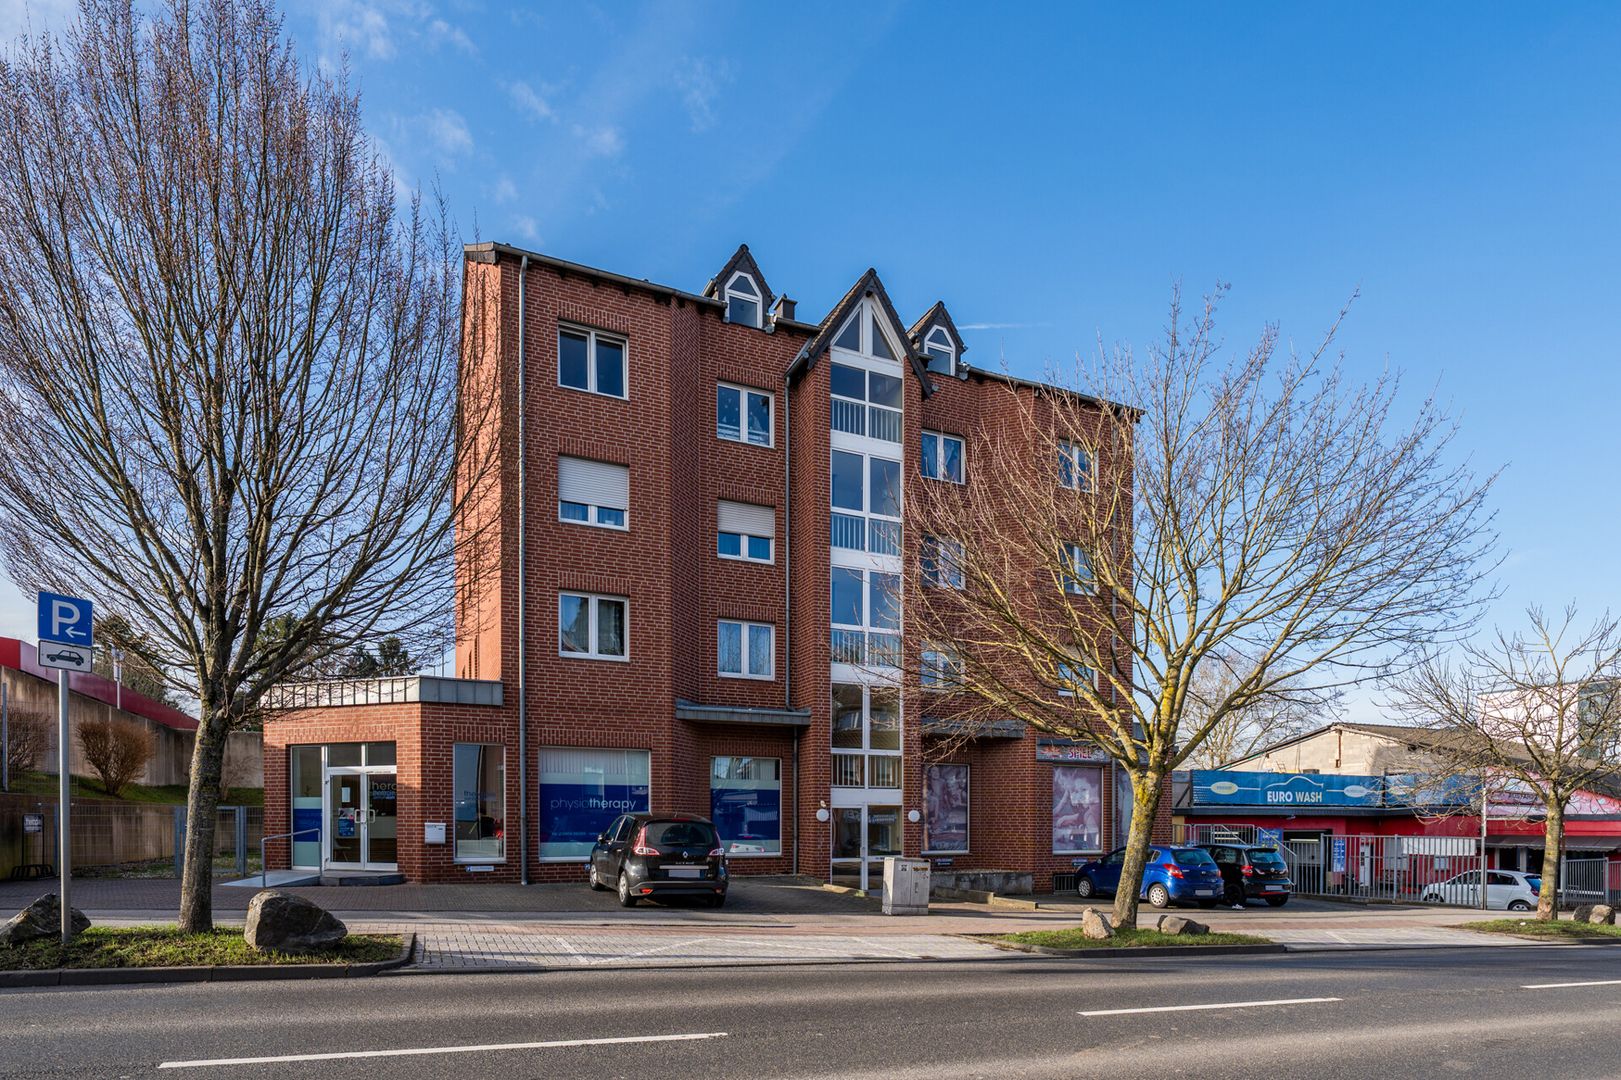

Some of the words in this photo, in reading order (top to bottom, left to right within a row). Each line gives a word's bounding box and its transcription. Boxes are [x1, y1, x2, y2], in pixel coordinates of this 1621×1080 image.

[52, 599, 81, 636] P
[1267, 790, 1293, 803] EURO
[1295, 791, 1323, 803] WASH
[550, 797, 637, 810] physiotherapy
